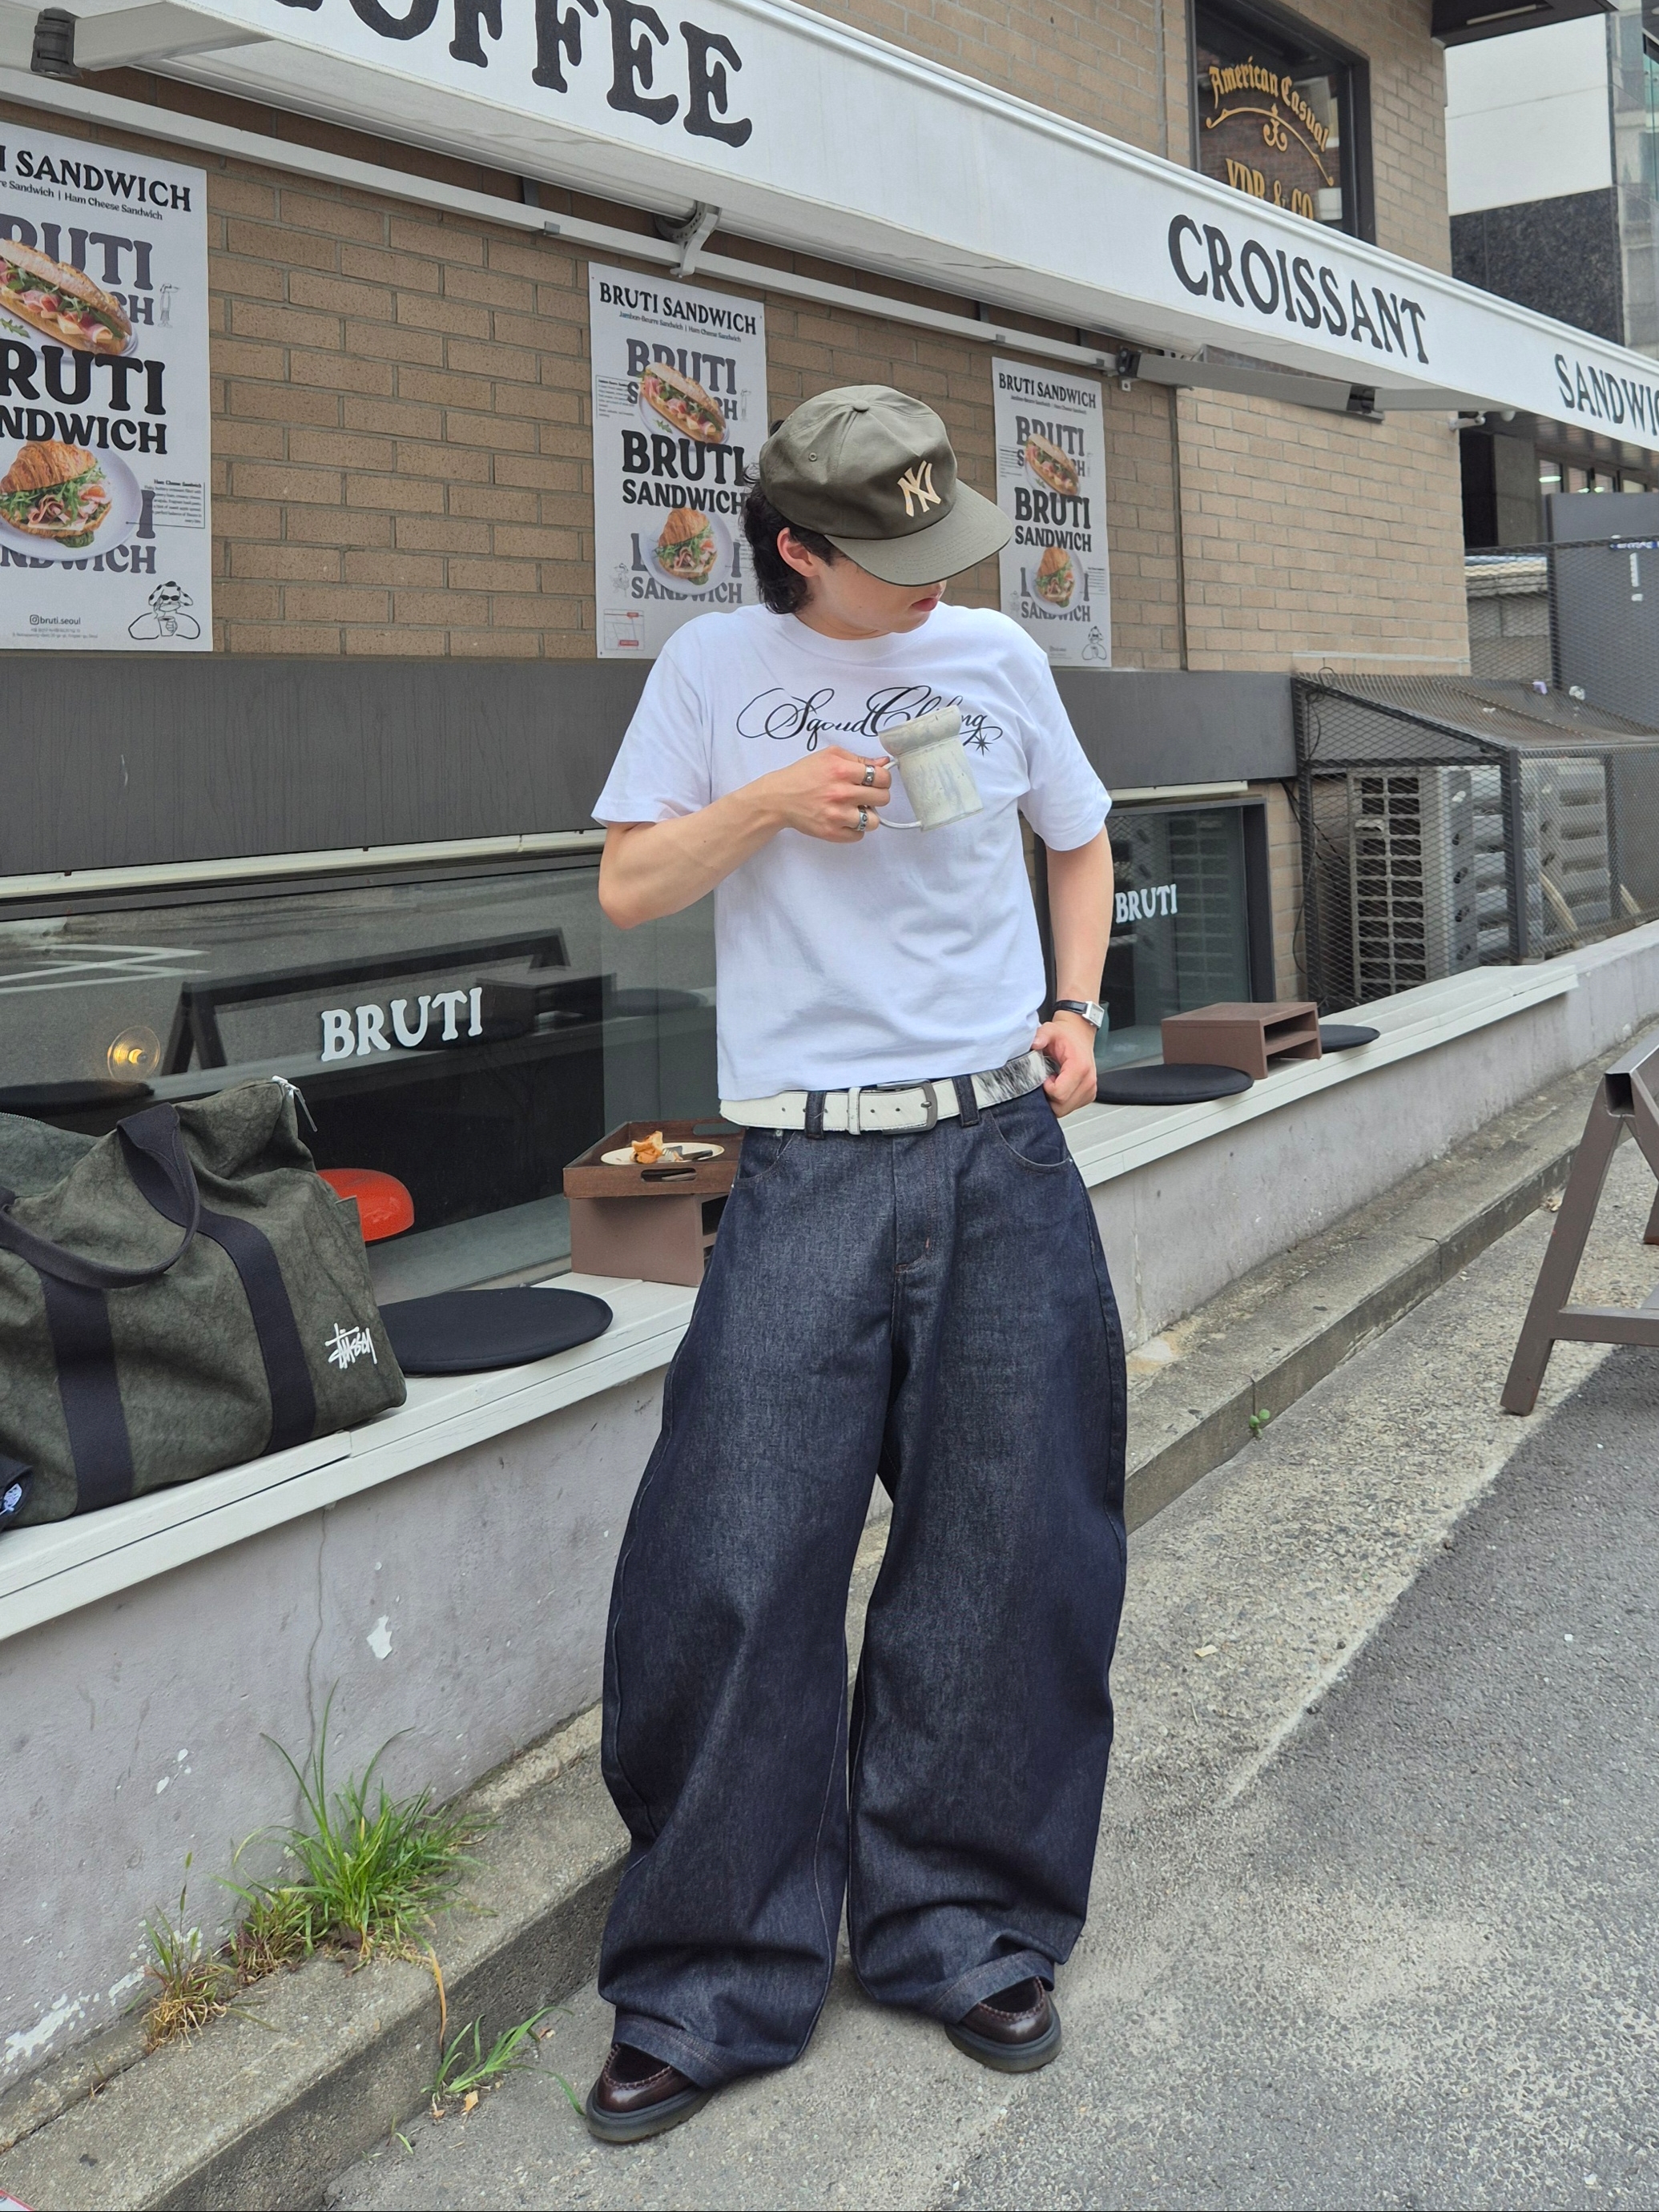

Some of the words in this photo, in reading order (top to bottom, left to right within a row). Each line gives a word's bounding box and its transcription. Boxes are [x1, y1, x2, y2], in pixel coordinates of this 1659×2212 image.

[272, 0, 753, 149] FFEE
[1209, 55, 1279, 110] American
[1281, 75, 1330, 152] Casual
[9, 180, 54, 198] Sandwich
[65, 192, 86, 204] Ham
[88, 197, 120, 211] Cheese
[122, 203, 163, 221] Sandwich
[16, 150, 192, 212] SANDWICH
[599, 282, 658, 314] BRUTI
[662, 296, 757, 336] SANDWICH
[1168, 214, 1430, 364] CROISSANT
[999, 372, 1035, 396] BRUTI
[1037, 381, 1097, 409] SANDWICH
[621, 429, 745, 487] BRUTI
[622, 479, 751, 515] SANDWICH
[897, 460, 941, 517] NY
[1014, 486, 1092, 529] BRUTI
[1015, 525, 1093, 553] SANDWICH
[1115, 883, 1178, 924] BRUTI
[321, 987, 484, 1063] BRUTI
